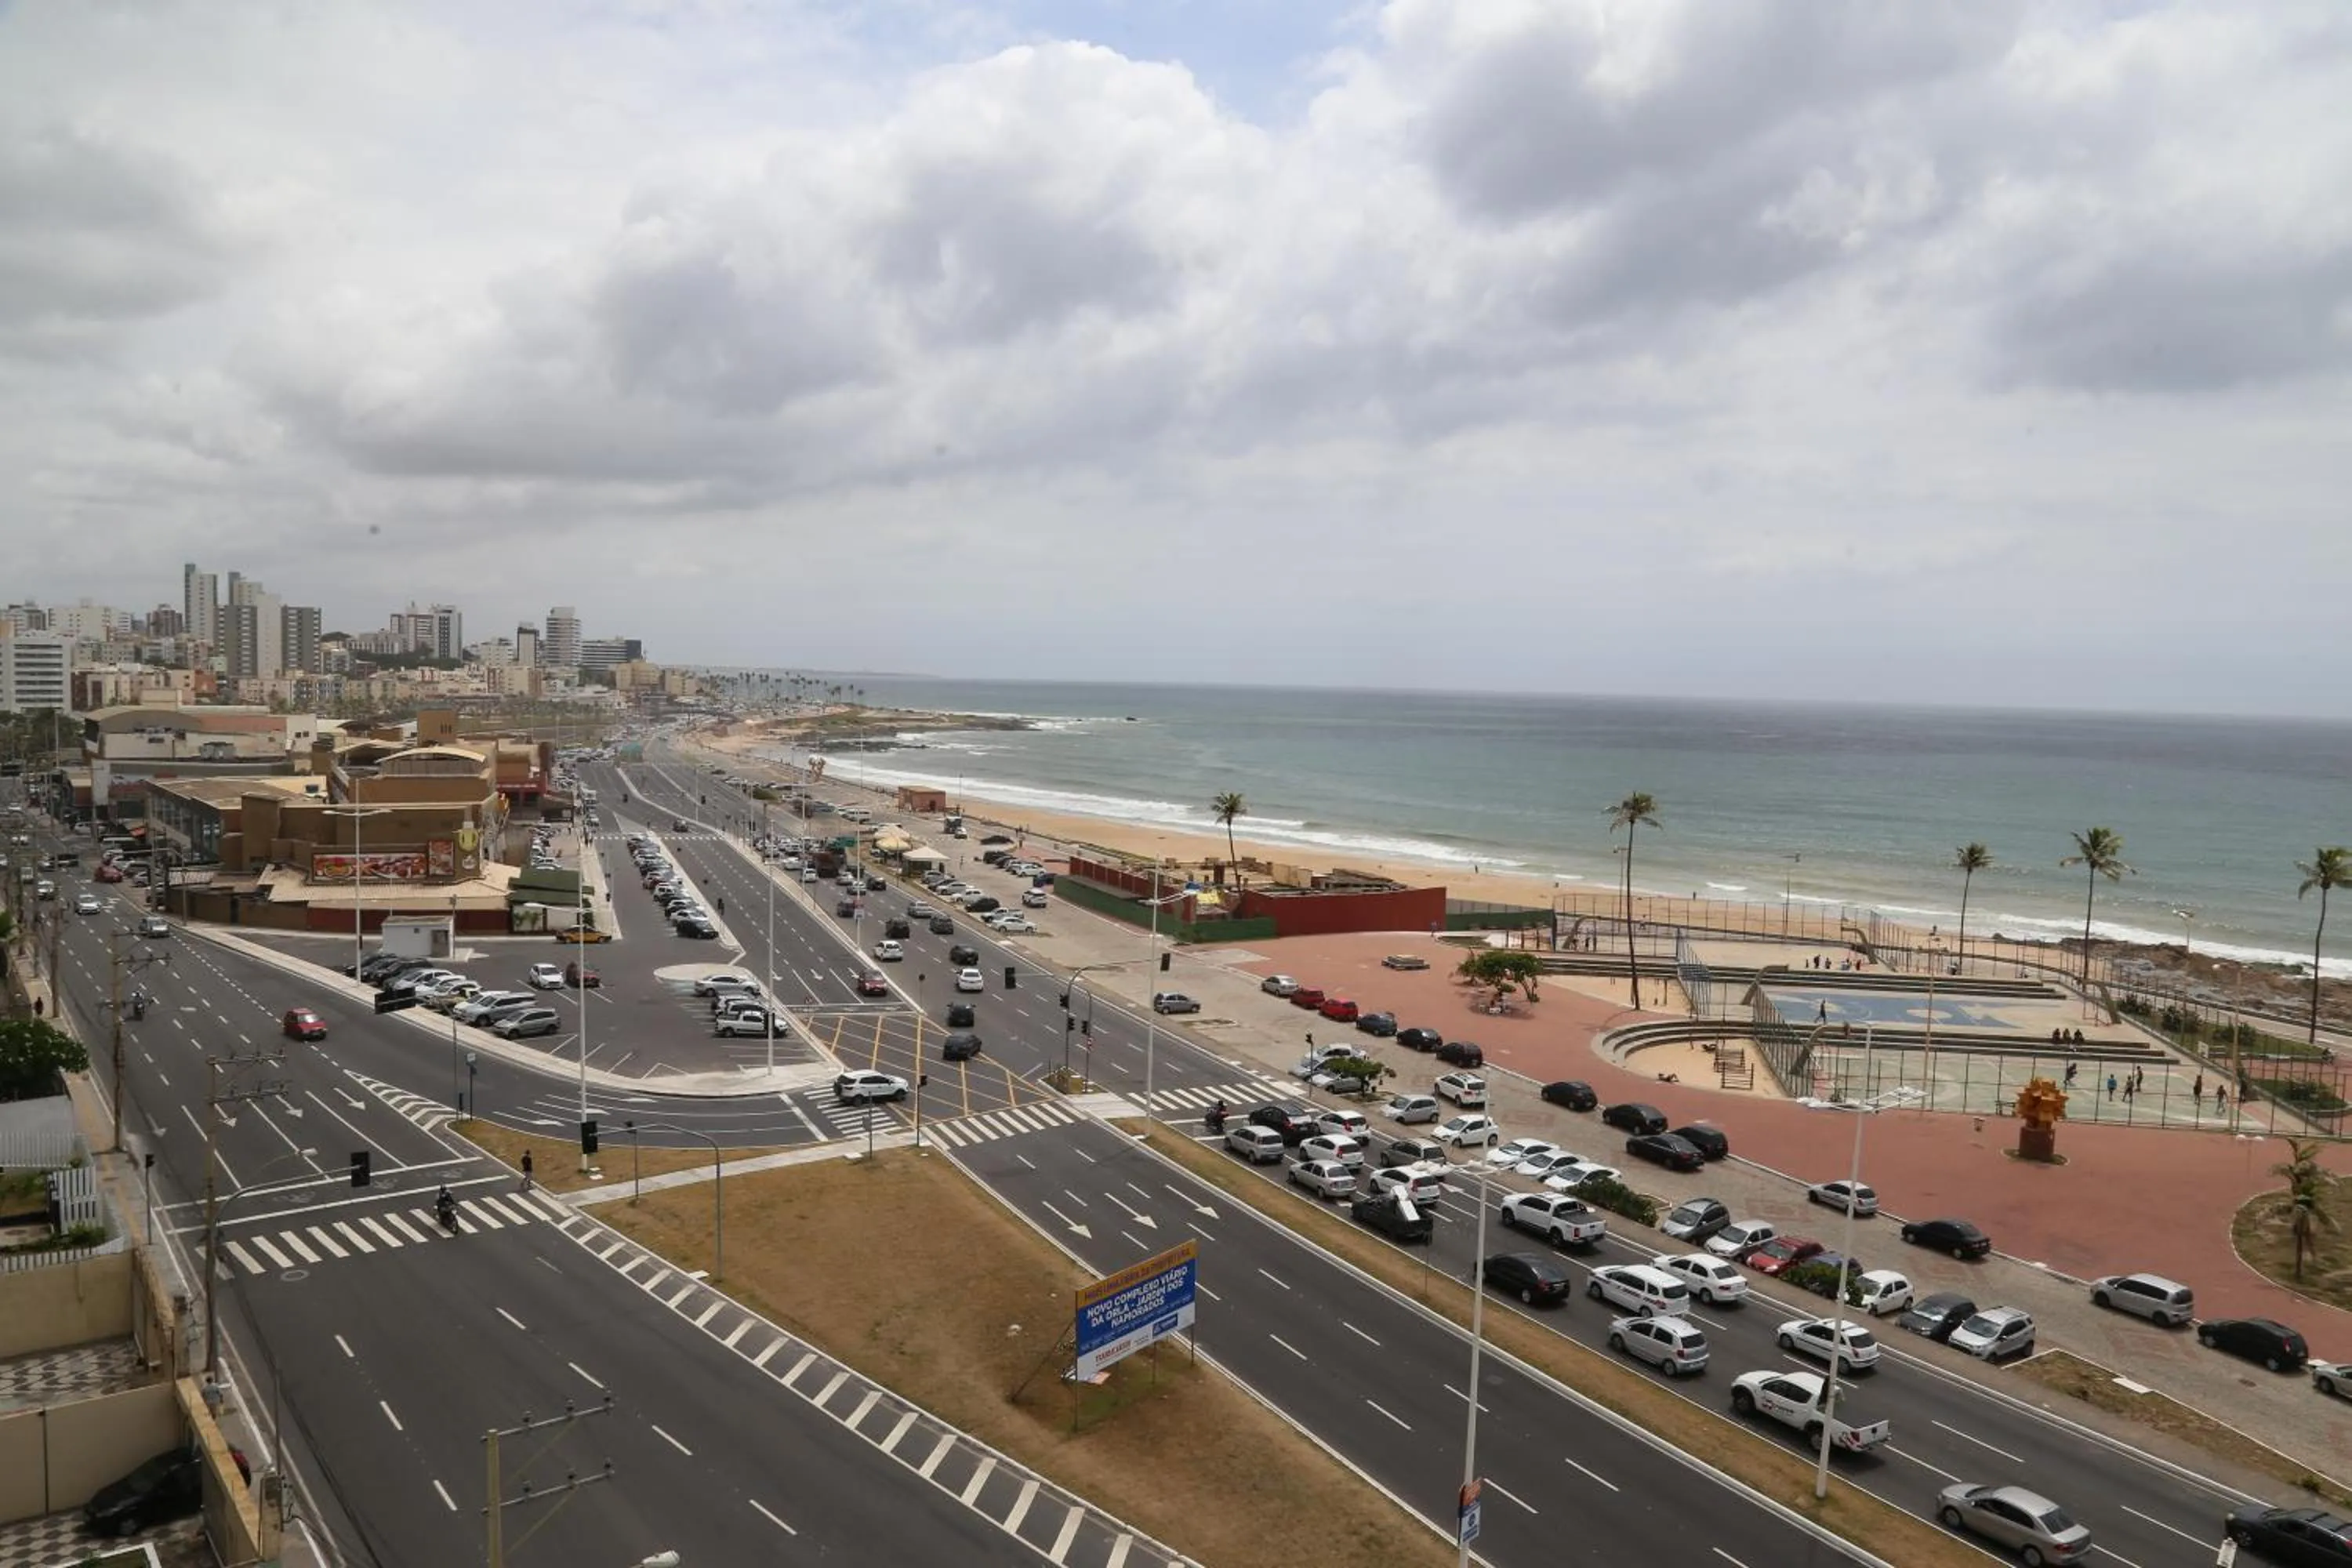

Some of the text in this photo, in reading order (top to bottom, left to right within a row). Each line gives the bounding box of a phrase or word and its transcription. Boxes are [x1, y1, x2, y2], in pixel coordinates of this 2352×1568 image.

[1087, 1300, 1112, 1319] NOVO
[1114, 1279, 1160, 1307] COMPLEXO
[1091, 1315, 1105, 1327] DA
[1106, 1303, 1129, 1320] ORLA
[1137, 1286, 1166, 1307] JARDIM
[1167, 1278, 1184, 1292] DOS
[1111, 1296, 1164, 1329] NAMORADOS
